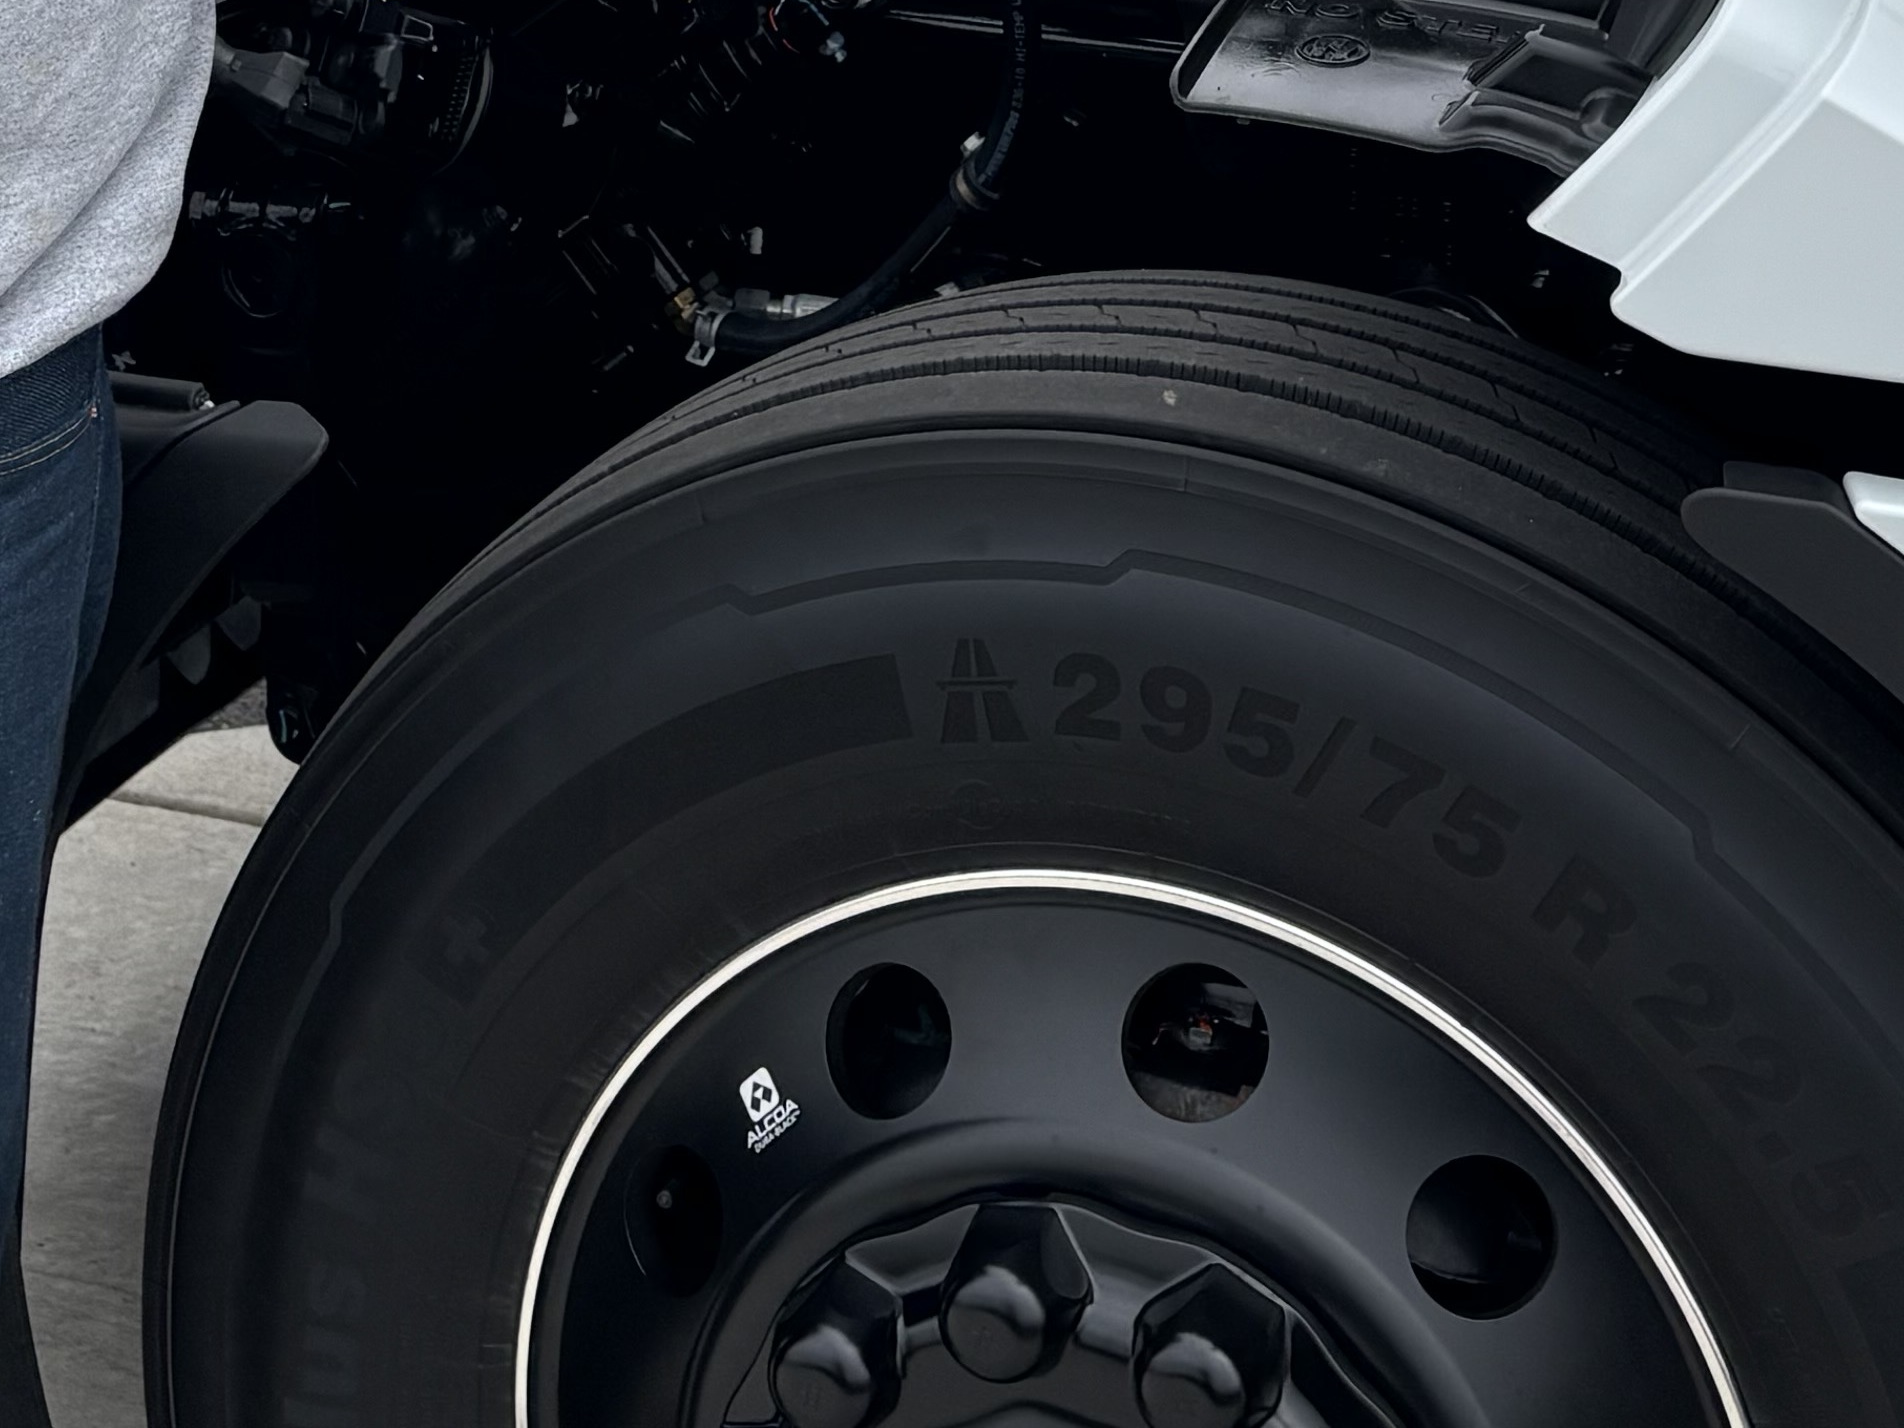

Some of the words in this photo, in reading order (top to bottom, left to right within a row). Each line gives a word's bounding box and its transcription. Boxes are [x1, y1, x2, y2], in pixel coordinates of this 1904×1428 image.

[1053, 651, 1521, 881] 295/75
[1533, 851, 1637, 962] R
[1634, 962, 1893, 1239] 22.5
[747, 1098, 799, 1149] ALCOA
